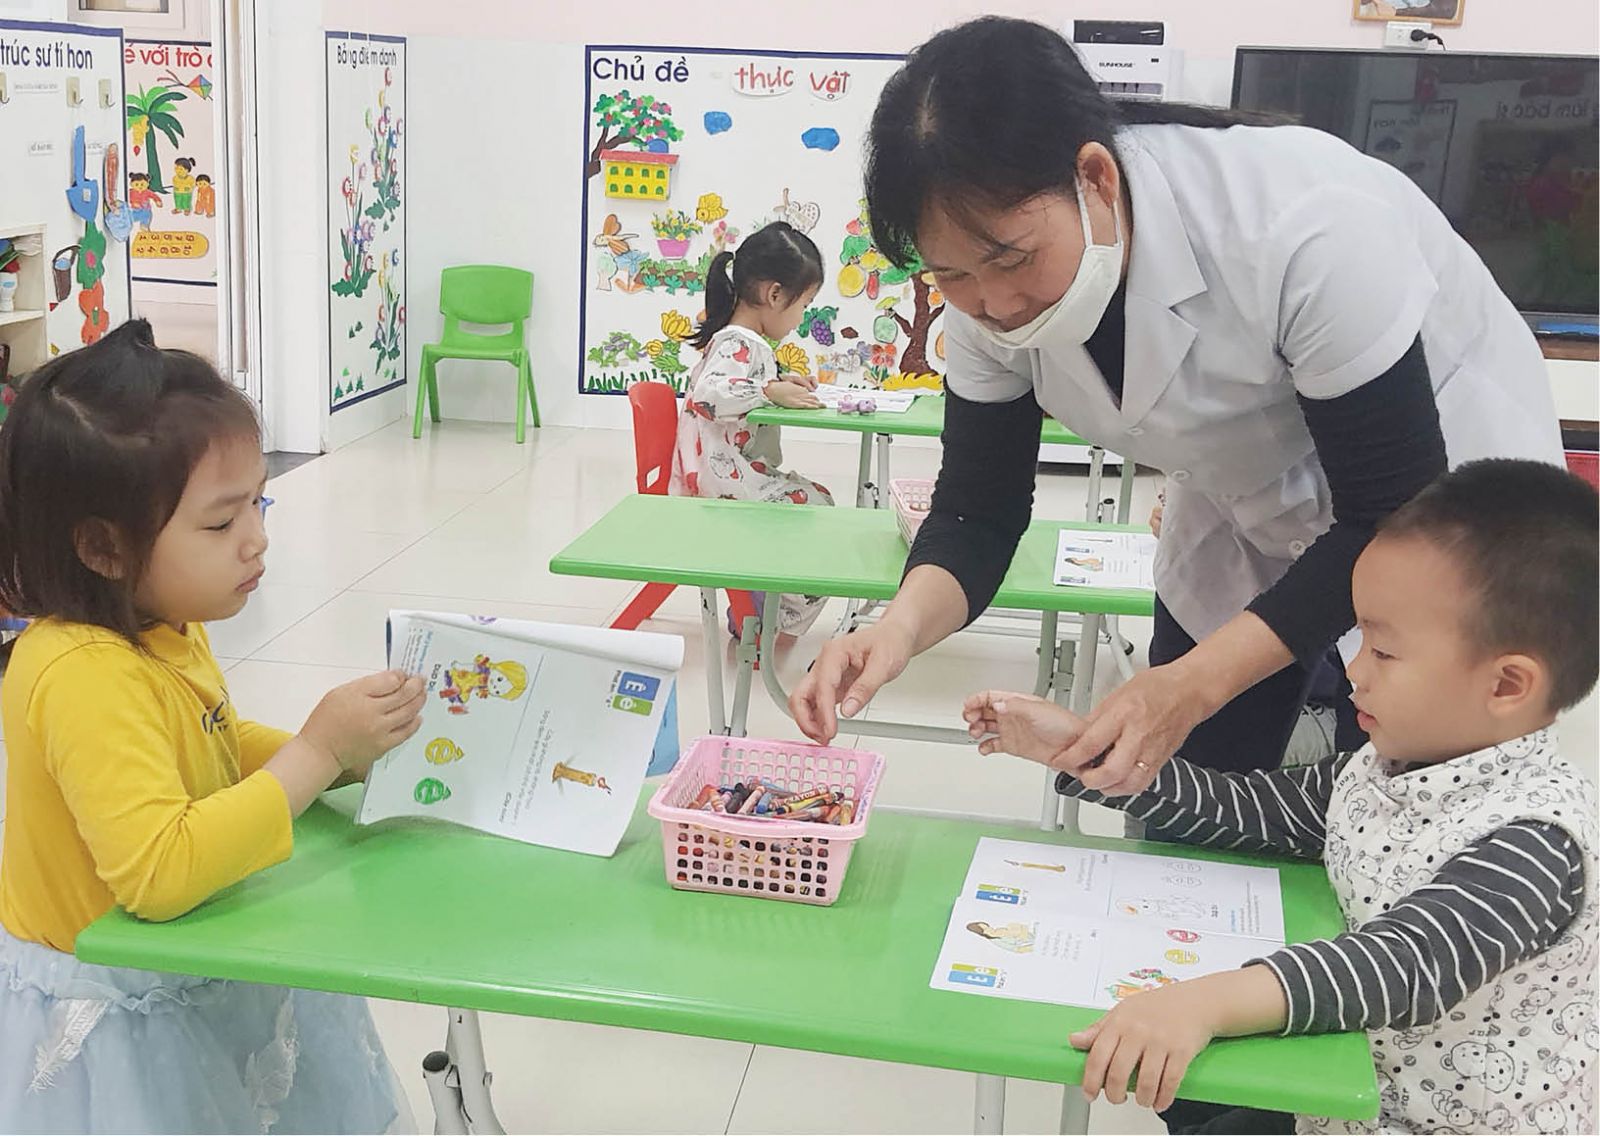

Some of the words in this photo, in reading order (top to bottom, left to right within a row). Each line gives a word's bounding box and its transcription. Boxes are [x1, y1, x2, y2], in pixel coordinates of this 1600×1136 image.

[0, 38, 30, 67] trúc
[35, 43, 52, 67] sư
[55, 41, 64, 68] tí
[66, 43, 93, 70] hon
[139, 43, 169, 66] với
[176, 44, 203, 67] trò
[379, 47, 397, 66] danh
[592, 55, 645, 82] Chủ
[654, 56, 690, 83] đề
[733, 62, 794, 94] thực
[809, 70, 851, 100] vật
